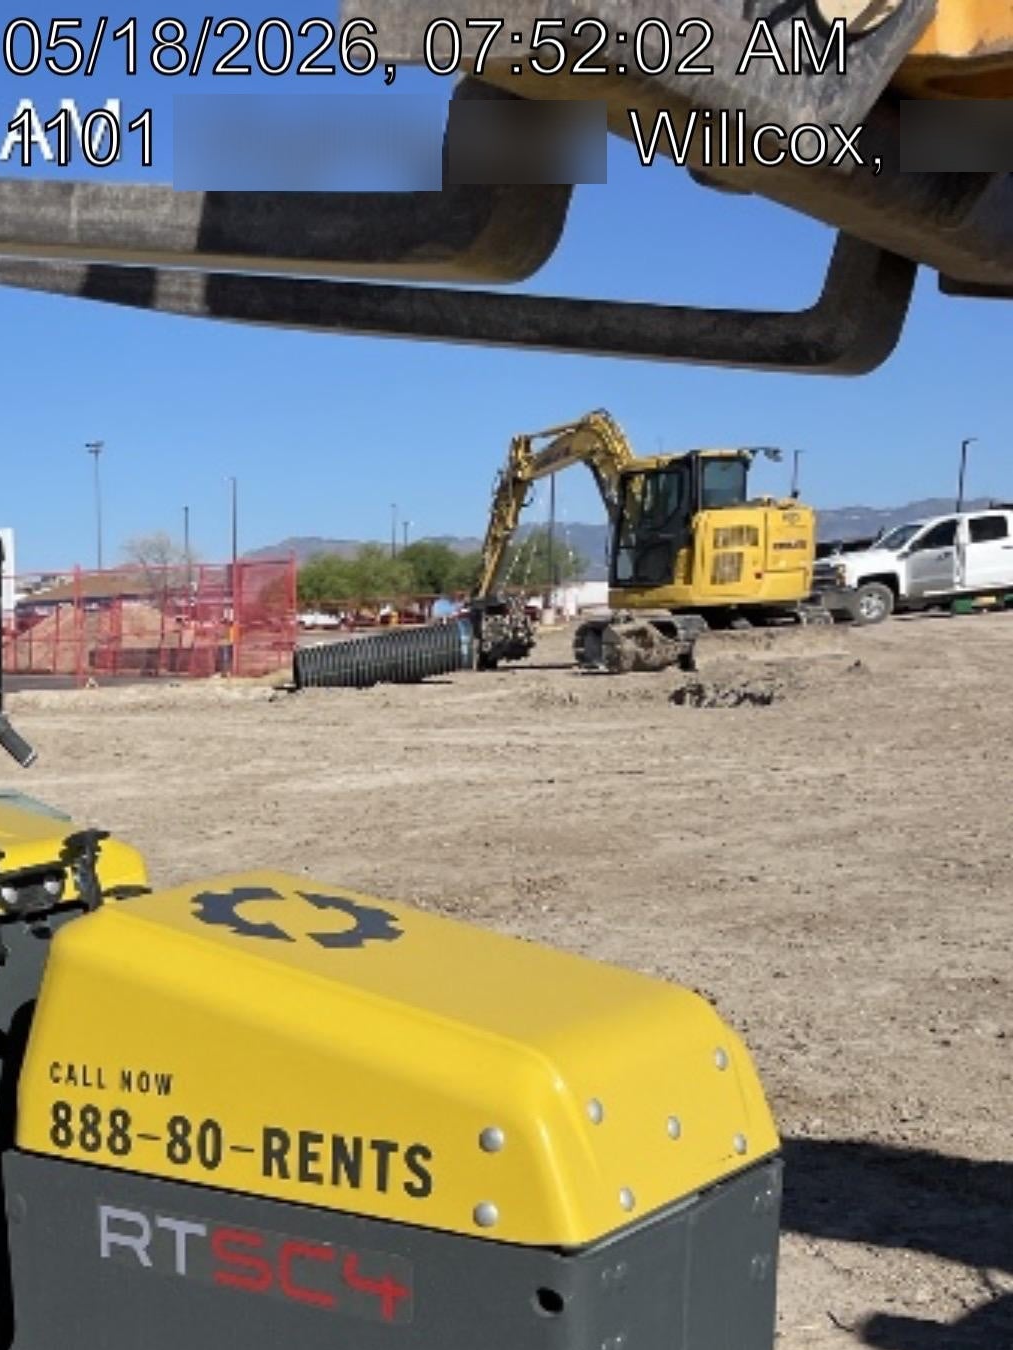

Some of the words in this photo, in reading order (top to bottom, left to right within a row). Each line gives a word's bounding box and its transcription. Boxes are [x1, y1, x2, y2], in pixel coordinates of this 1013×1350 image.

[49, 1061, 107, 1090] CALL
[120, 1069, 174, 1096] NOW
[50, 1100, 434, 1199] 888-80-RENTS
